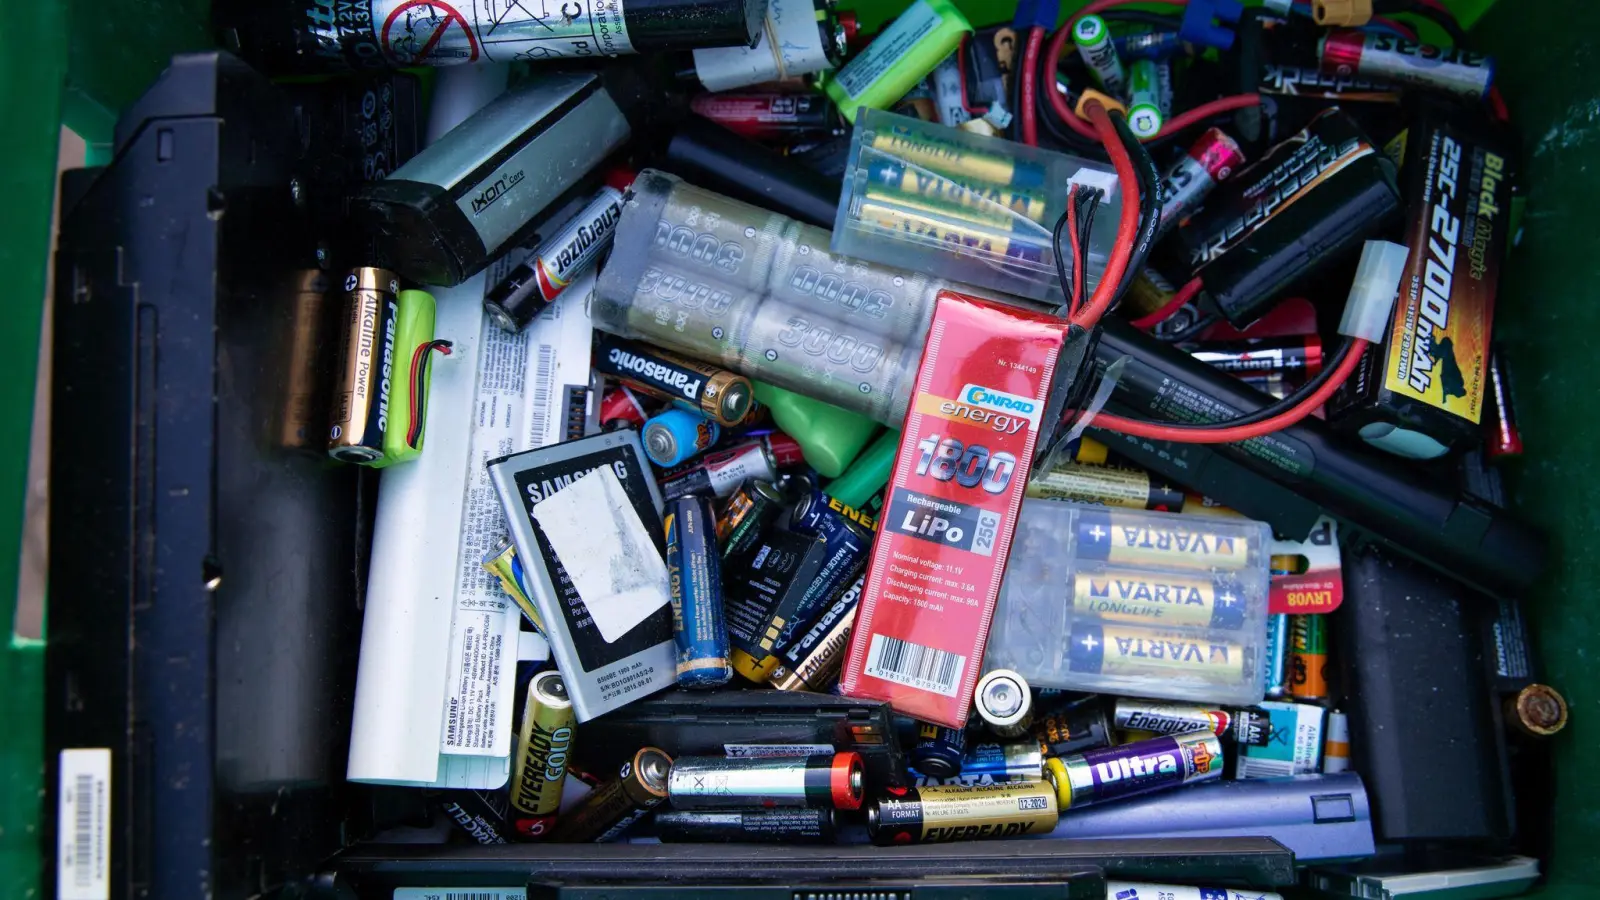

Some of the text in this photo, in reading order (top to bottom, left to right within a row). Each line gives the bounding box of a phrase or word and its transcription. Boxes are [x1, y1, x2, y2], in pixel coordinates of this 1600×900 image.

[594, 0, 615, 52] Corporatio
[1476, 152, 1505, 222] Black
[554, 203, 622, 277] Energizer
[356, 293, 379, 399] Alkaline Power
[778, 317, 883, 373] 3000
[376, 300, 399, 433] Panasonic
[609, 347, 701, 400] Panasonic
[967, 386, 1035, 414] CONRAD
[940, 401, 1027, 434] energy
[916, 433, 1017, 496] 1800
[527, 460, 628, 504] SAMG
[906, 493, 962, 516] Rechargeable
[901, 509, 964, 542] LiPo
[973, 515, 997, 550] 25C
[1123, 524, 1209, 548] VARTA
[824, 544, 847, 571] MADE
[888, 564, 918, 580] Charging
[892, 551, 919, 565] Nominal
[945, 564, 963, 575] 11.1V
[663, 563, 688, 630] ENERGY
[794, 574, 824, 614] GERMANY
[882, 590, 912, 605] Capacity:
[885, 577, 924, 595] Discharging
[1115, 580, 1204, 606] VARTA
[1286, 587, 1332, 608] LRV08
[786, 574, 866, 662] Panason
[803, 626, 851, 679] Alkaline
[1115, 635, 1204, 663] VARTA
[446, 698, 459, 745] SAMSUNG
[456, 711, 466, 746] Rechargeable
[461, 675, 470, 696] Battery
[1122, 710, 1207, 737] Energizer
[472, 722, 481, 748] Standard
[517, 719, 553, 813] EVEREADY
[544, 726, 573, 784] GOLD
[886, 798, 901, 810] AA
[905, 800, 920, 809] SIZE
[944, 785, 972, 794] ALKALINE
[891, 808, 920, 818] FORMAT
